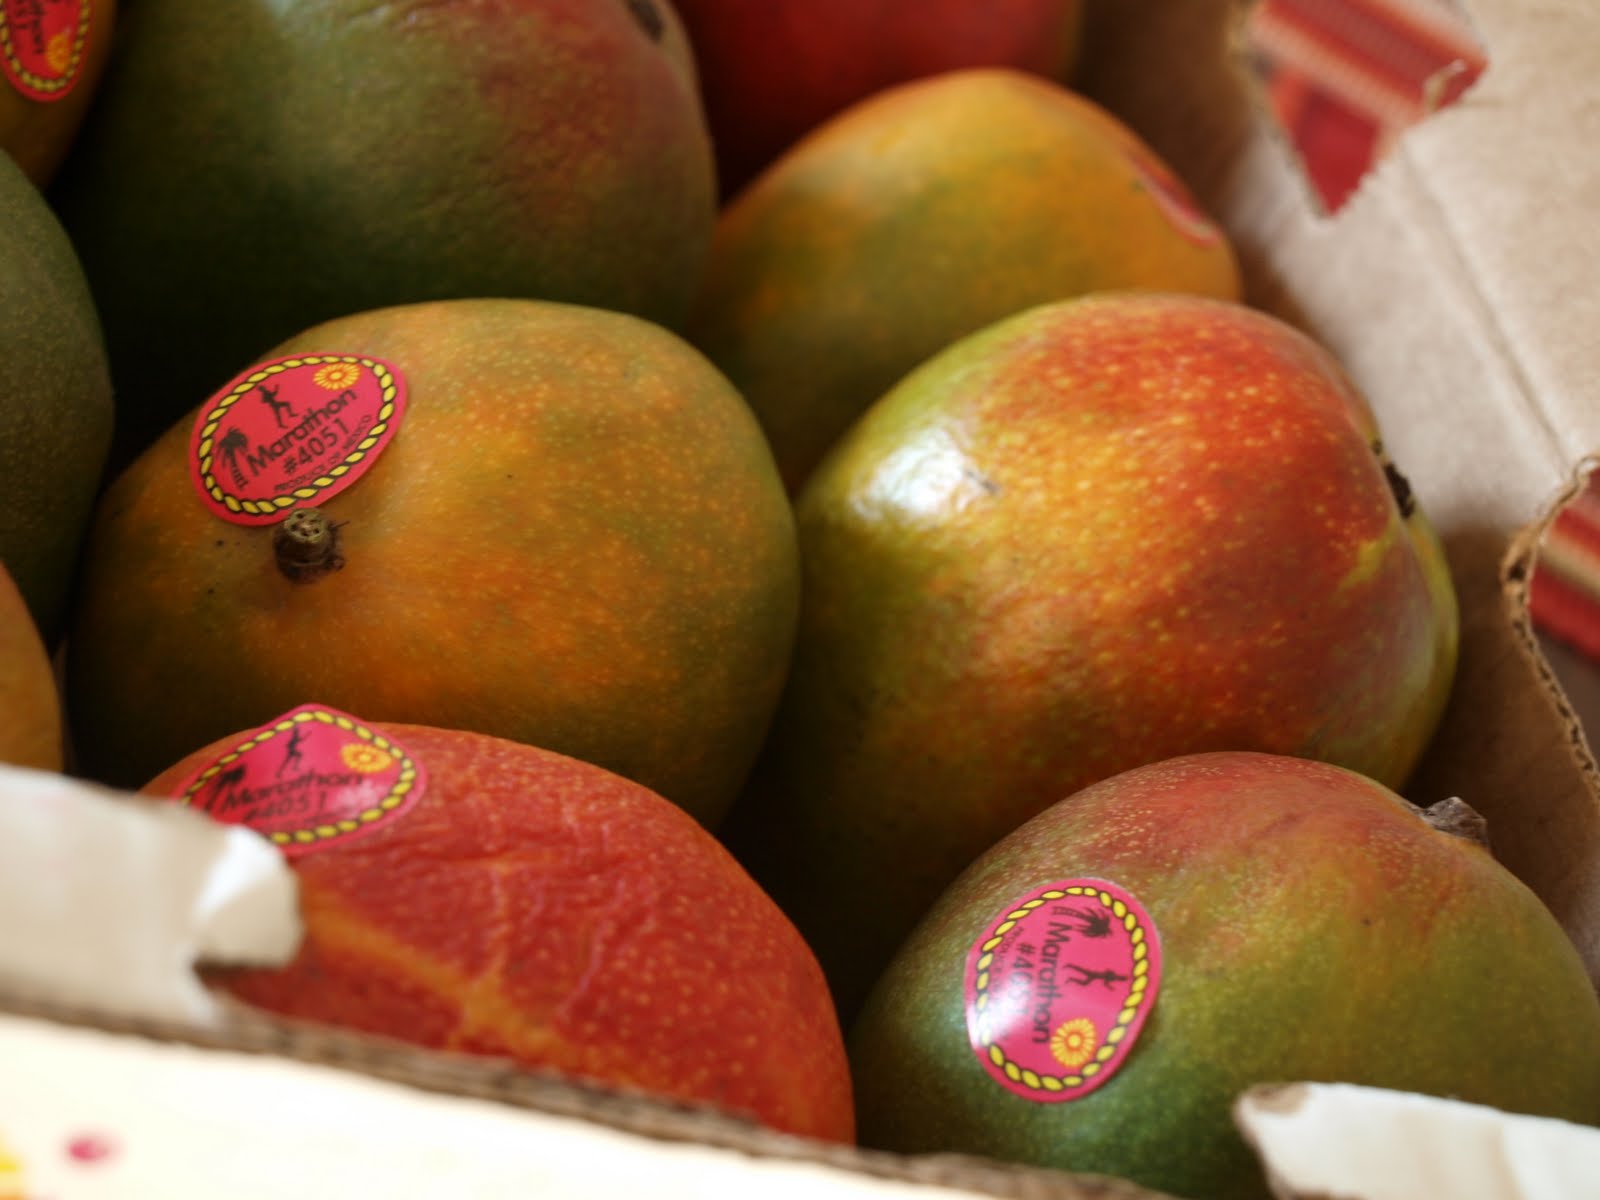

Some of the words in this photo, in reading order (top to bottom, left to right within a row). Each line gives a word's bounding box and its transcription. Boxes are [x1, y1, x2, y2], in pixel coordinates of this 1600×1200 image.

[246, 388, 358, 477] Marathon
[283, 418, 351, 475] #4051
[1032, 921, 1073, 1044] Marathon
